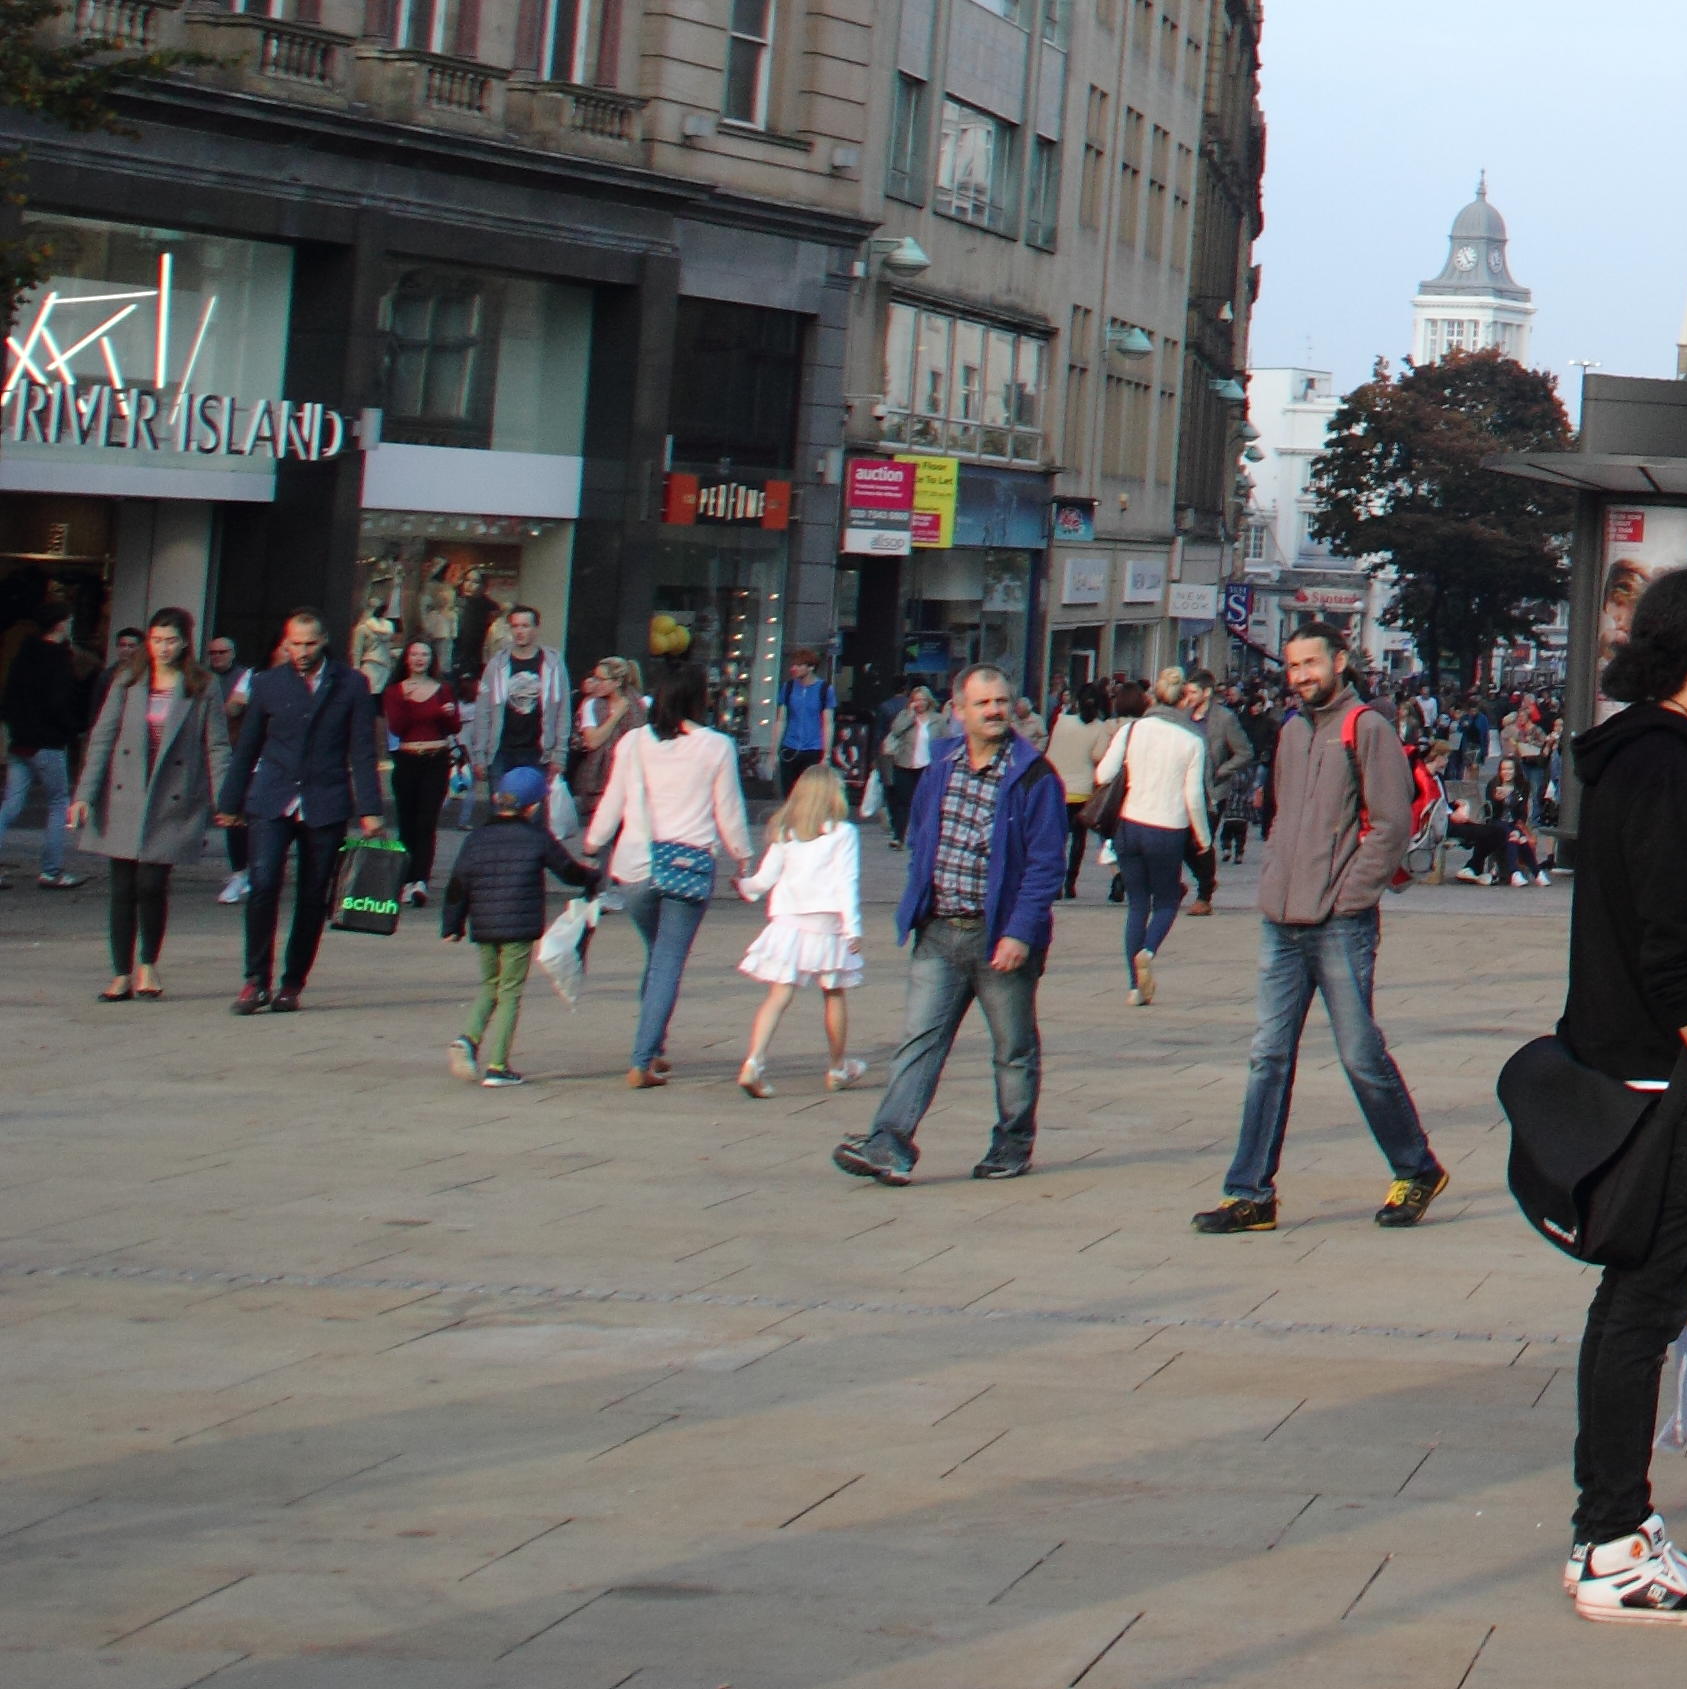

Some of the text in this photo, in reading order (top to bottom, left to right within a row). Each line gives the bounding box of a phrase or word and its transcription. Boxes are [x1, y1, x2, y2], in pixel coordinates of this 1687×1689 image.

[12, 377, 345, 461] RIVER ISLAND
[855, 466, 904, 482] auction
[699, 482, 766, 520] PERFUME
[1175, 592, 1208, 601] NEW
[1312, 592, 1362, 604] Santand
[1172, 601, 1211, 610] LOOK
[343, 896, 398, 915] schuh
